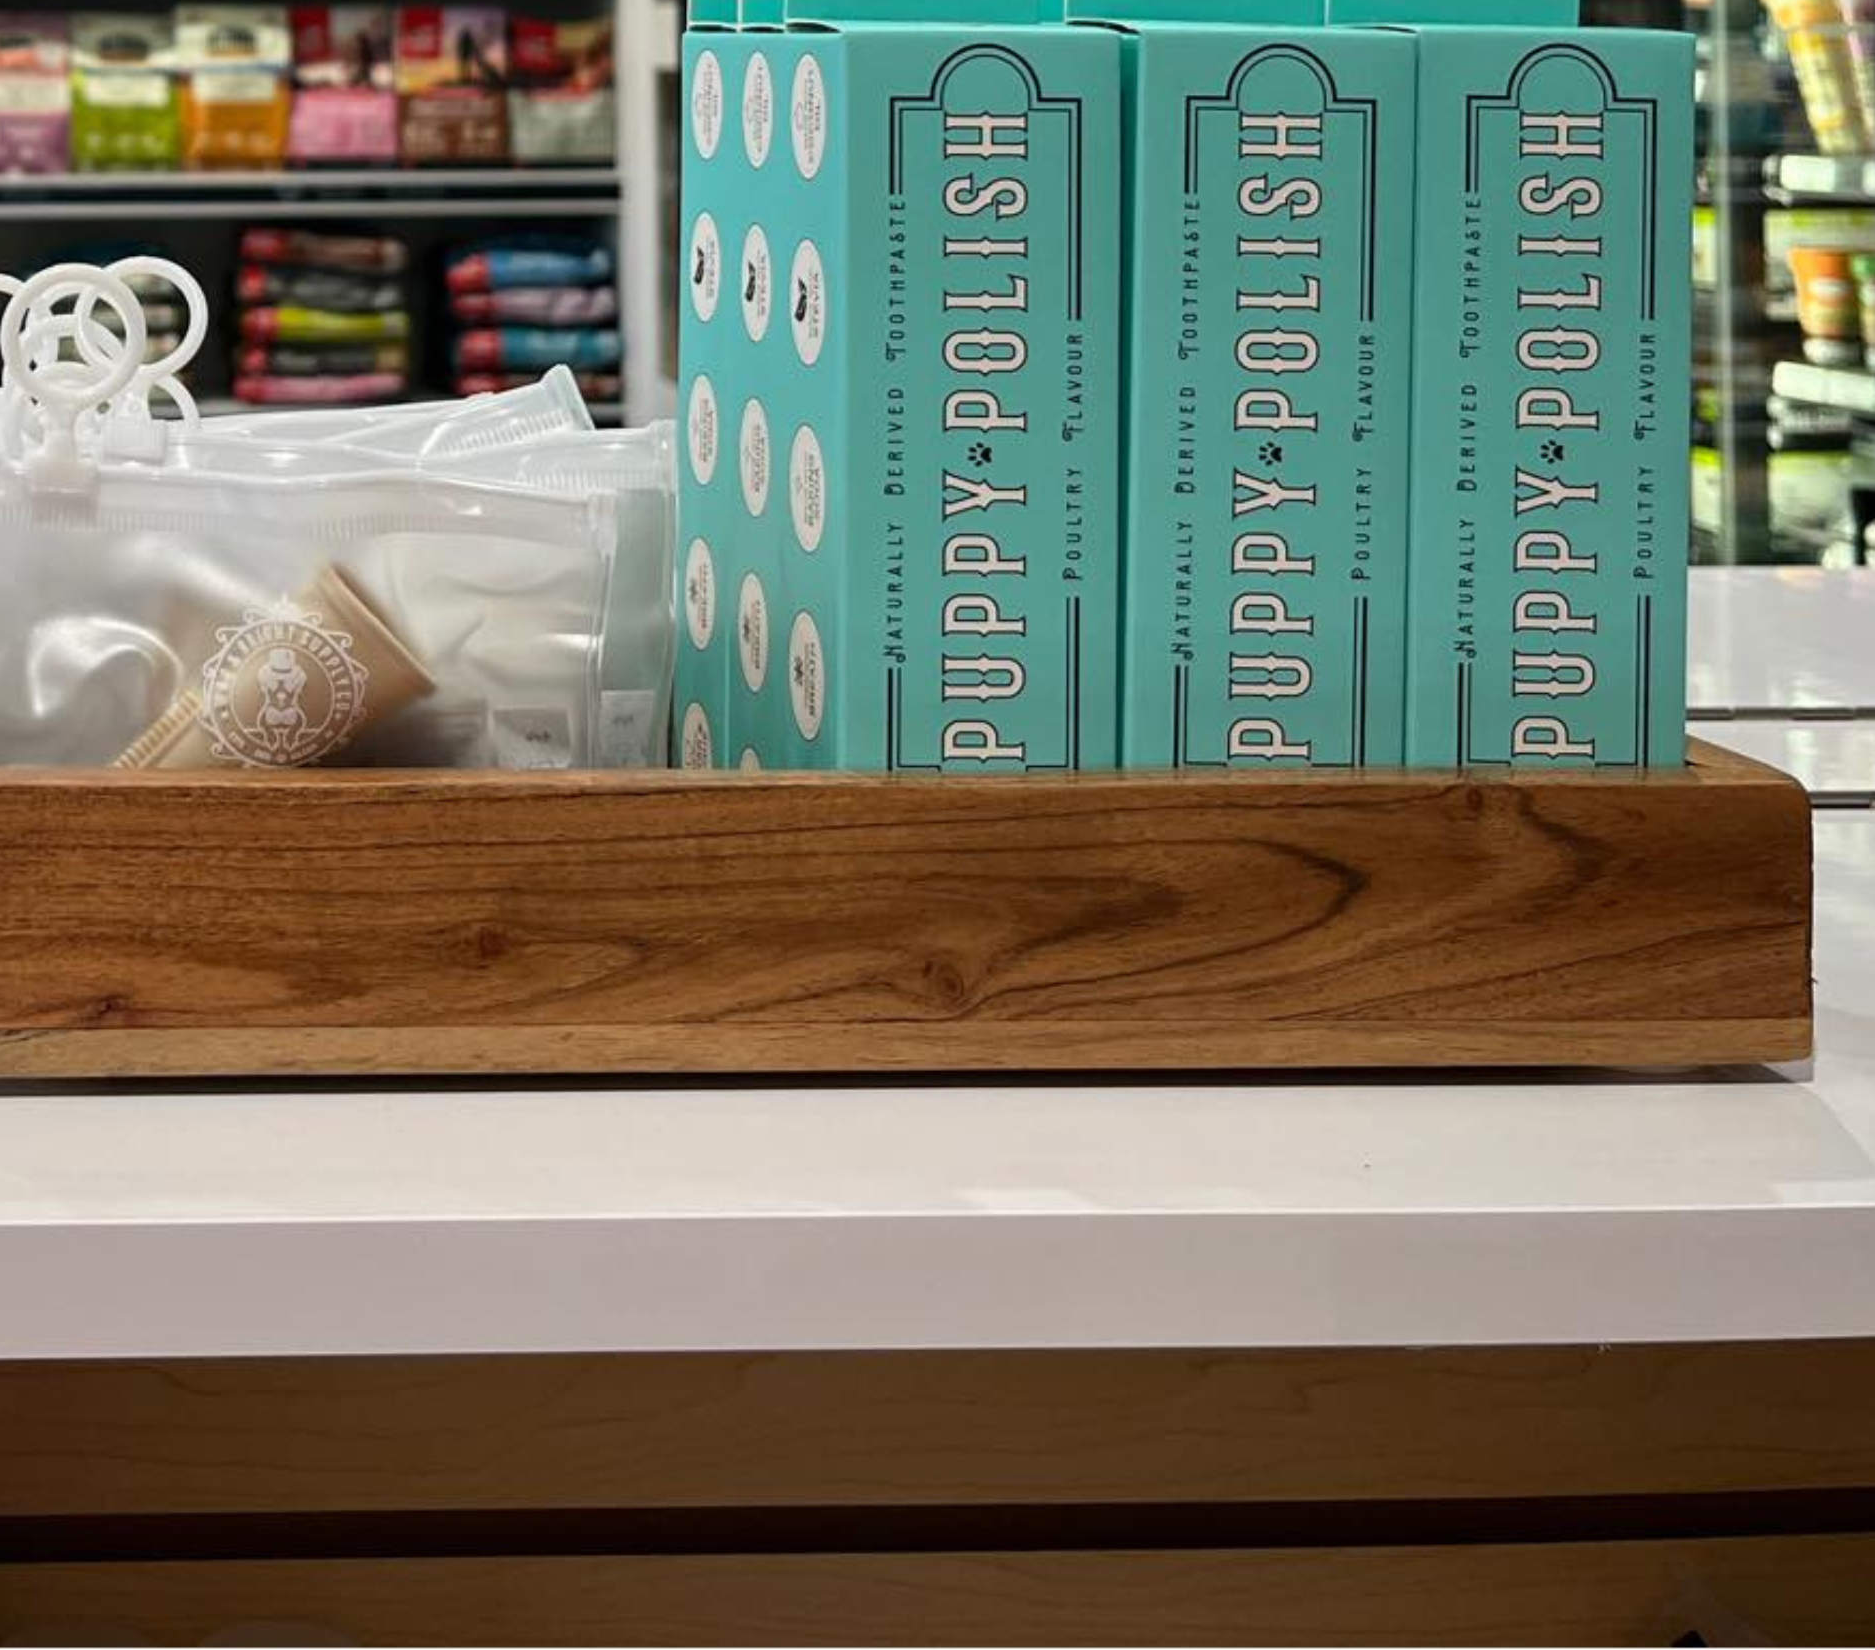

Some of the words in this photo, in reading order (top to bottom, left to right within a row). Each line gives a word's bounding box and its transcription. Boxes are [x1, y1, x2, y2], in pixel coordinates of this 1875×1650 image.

[885, 200, 906, 361] TOOTHPASTE
[941, 112, 1028, 432] POLISH
[1178, 200, 1201, 360] TOOTHPASTE
[1233, 110, 1323, 432] POLISH
[1459, 198, 1482, 359] TOOTHPASTE
[1515, 110, 1604, 431] POLISH
[884, 387, 905, 496] DERIVED
[1062, 333, 1084, 443] FLAVOUR
[1174, 386, 1197, 494] DERIVED
[1352, 333, 1375, 442] FLAVOUR
[1456, 382, 1478, 492] DERIVED
[1634, 333, 1657, 440] FLAVOUR
[884, 522, 906, 664] NATURALLY
[1062, 467, 1083, 581] POULTRY
[1172, 520, 1195, 662] NATURALLY
[1351, 467, 1373, 580] POULTRY
[1454, 518, 1477, 659] NATURALLY
[1634, 466, 1655, 579] POULTRY
[941, 469, 1027, 762] PUPPY
[1227, 467, 1317, 761] PUPPY
[1511, 465, 1599, 759] PUPPY
